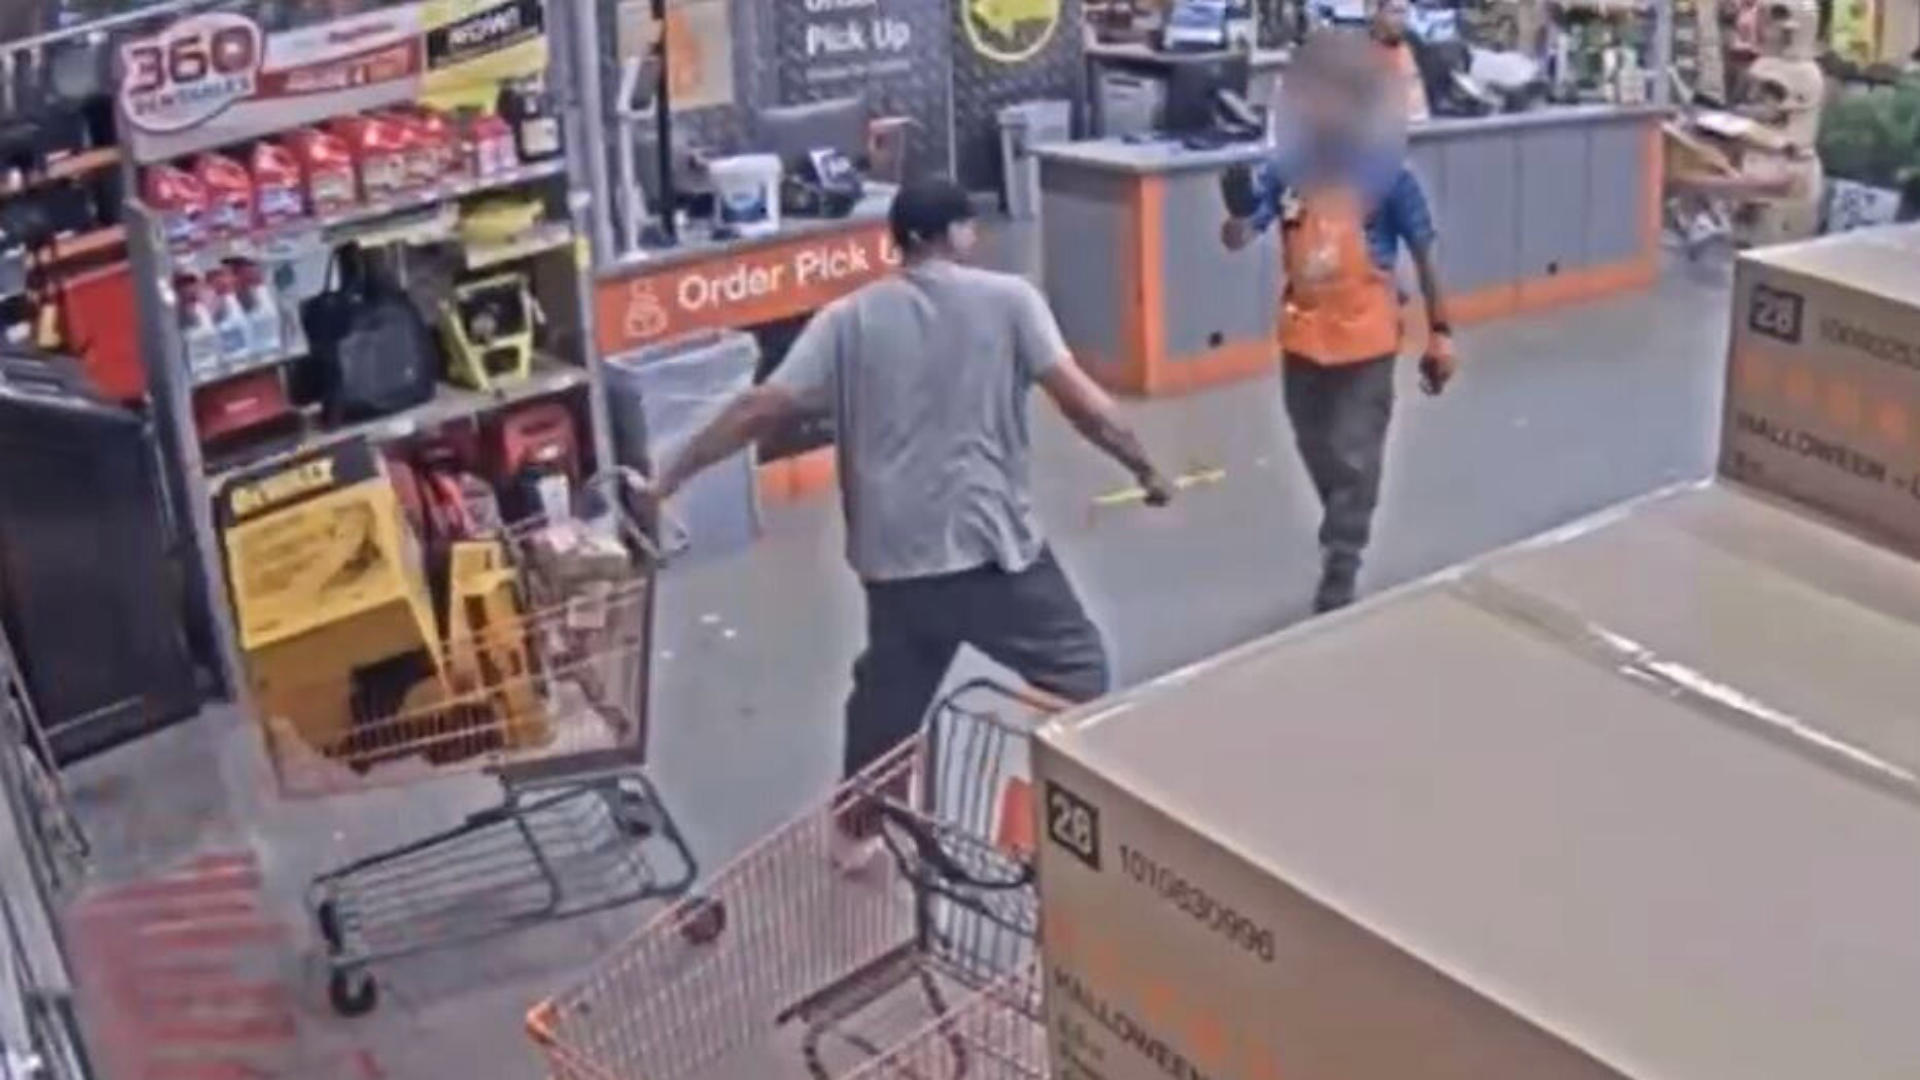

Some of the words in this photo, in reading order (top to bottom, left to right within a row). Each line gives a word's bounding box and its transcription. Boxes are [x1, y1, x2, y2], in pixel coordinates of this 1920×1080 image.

[129, 25, 255, 96] 360
[807, 21, 867, 55] Pick
[872, 18, 910, 51] Up
[677, 262, 784, 310] Order
[795, 238, 870, 284] Pick
[880, 235, 902, 265] U
[1755, 296, 1796, 335] 28
[1052, 790, 1093, 856] 28
